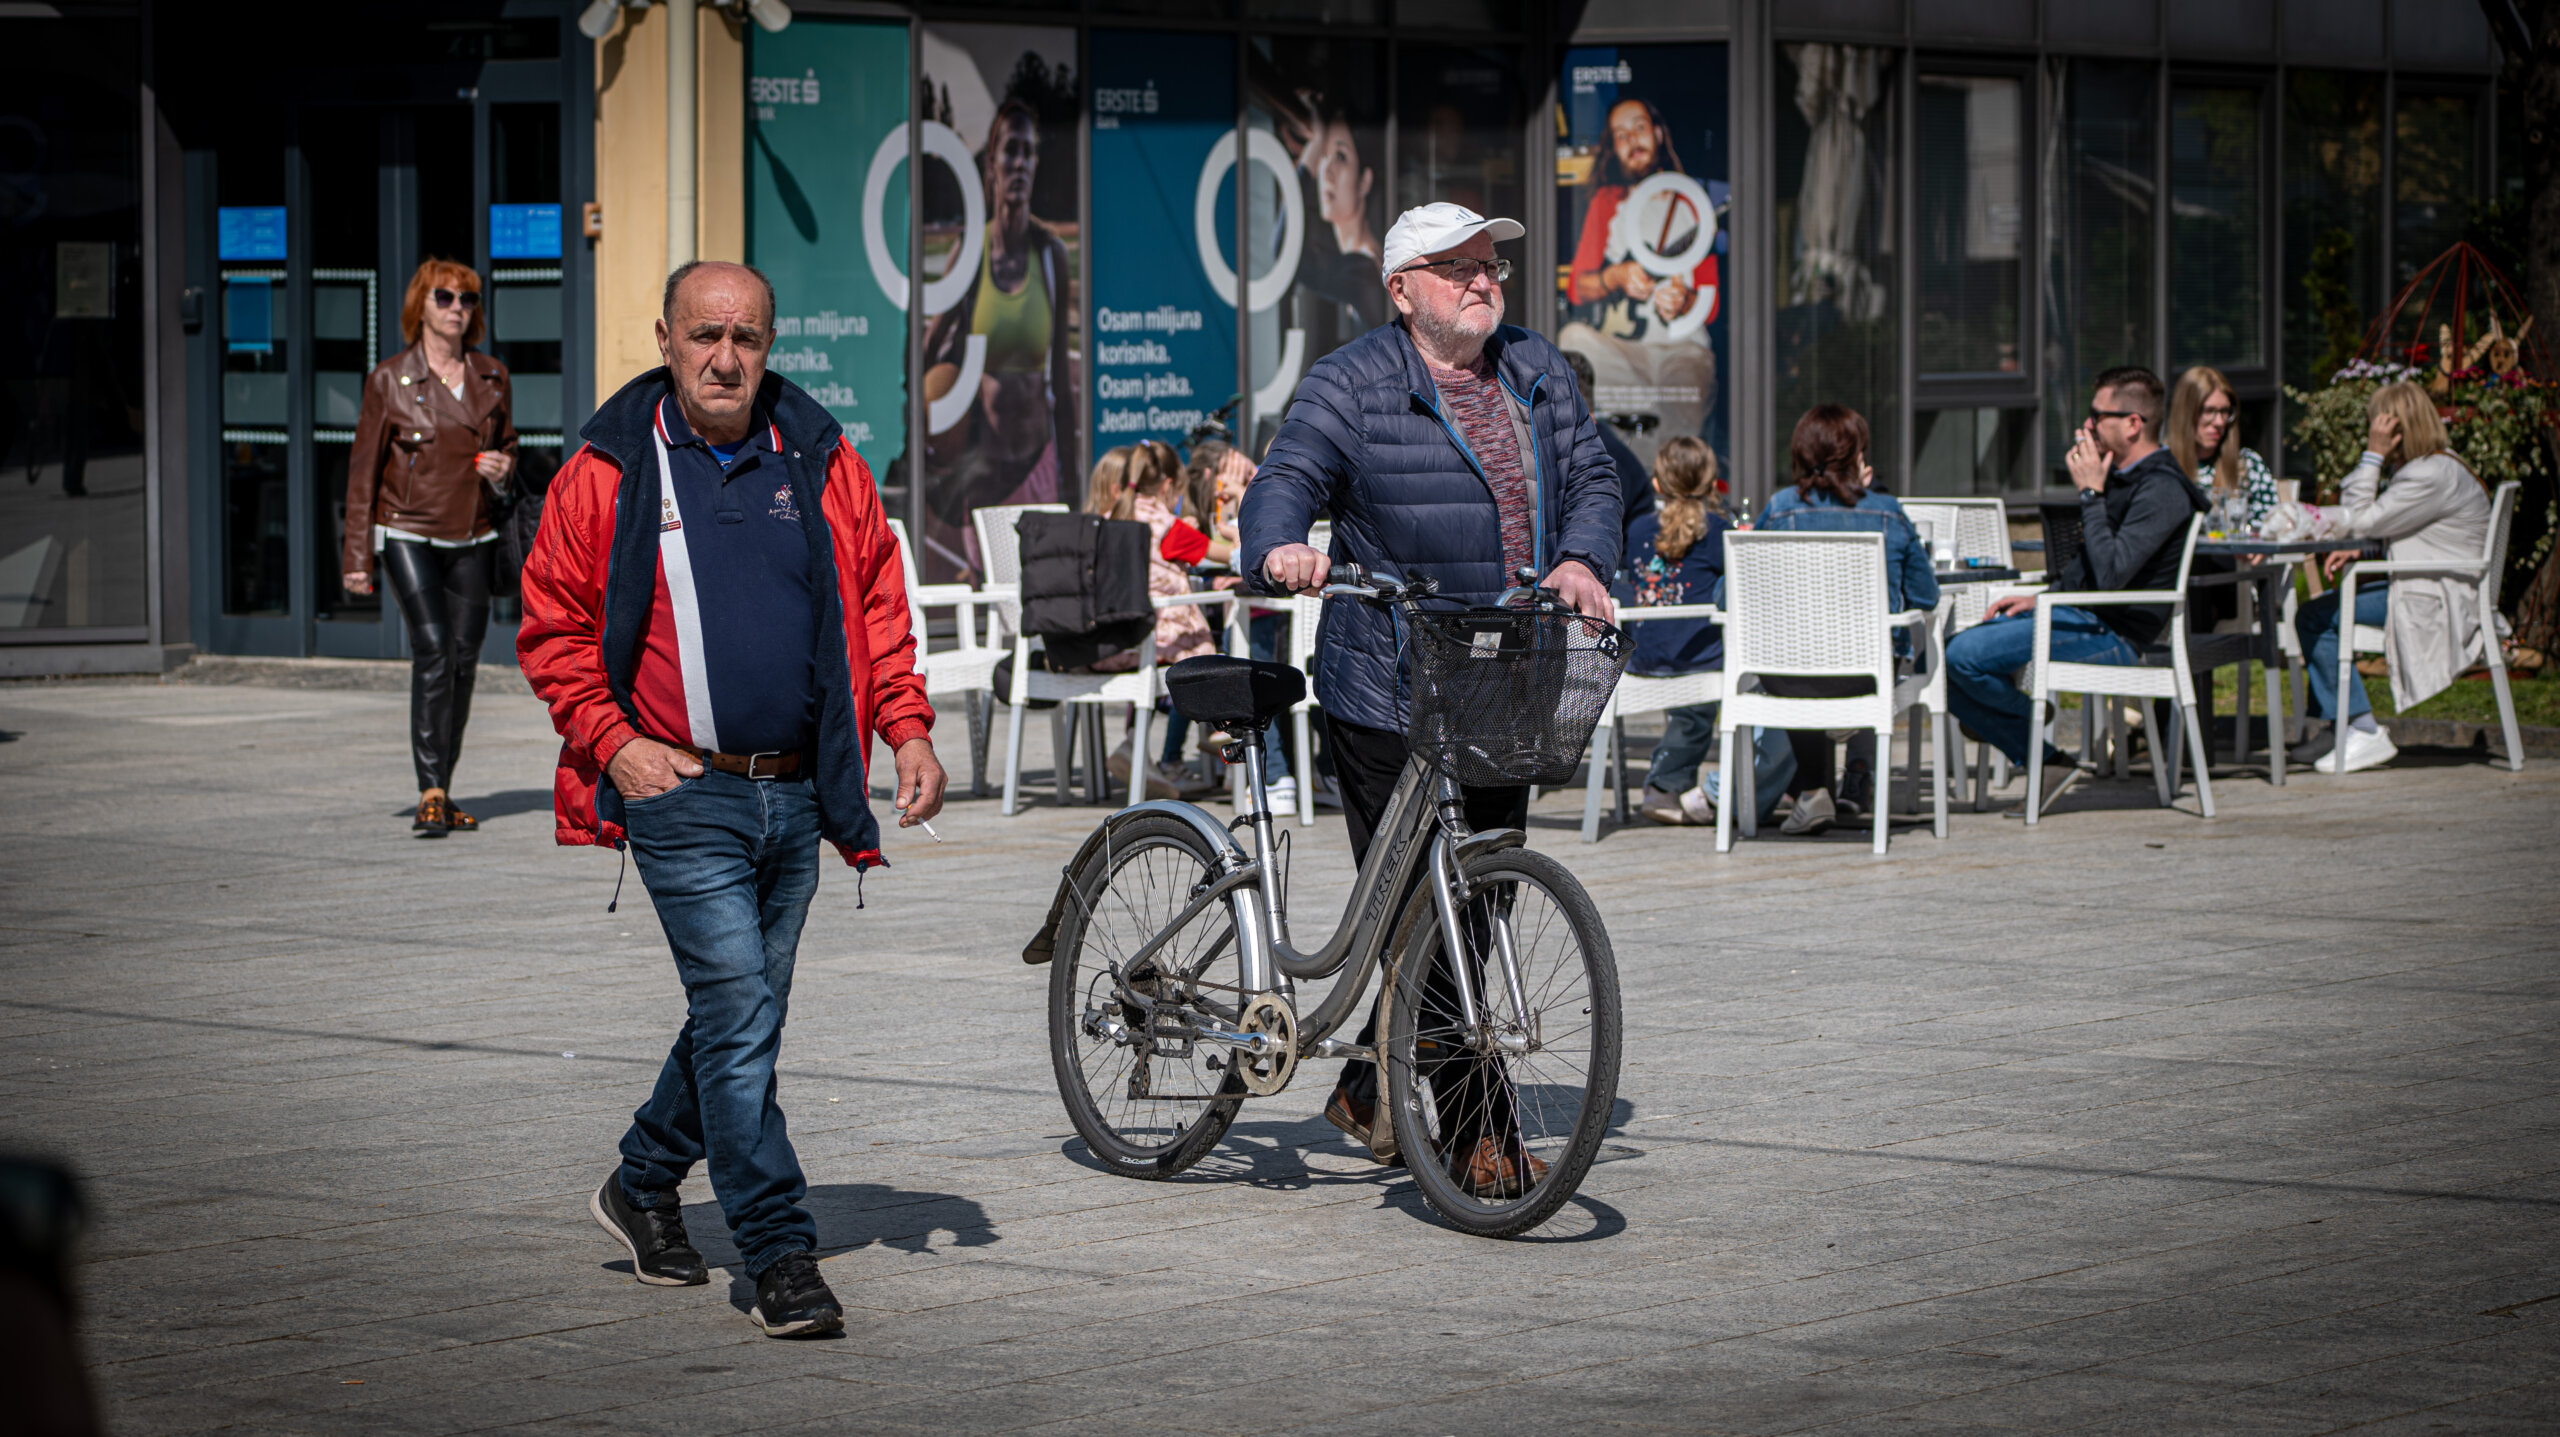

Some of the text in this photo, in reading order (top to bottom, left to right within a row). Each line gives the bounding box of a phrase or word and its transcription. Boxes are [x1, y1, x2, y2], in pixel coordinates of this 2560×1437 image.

[804, 310, 868, 342] milijuna
[1097, 305, 1202, 336] Osam milijuna
[767, 347, 833, 372] orisnika.
[1098, 339, 1171, 365] korisnika.
[1097, 371, 1194, 404] Osam jezika.
[1098, 407, 1145, 433] Jedan
[1365, 829, 1408, 921] TREK
